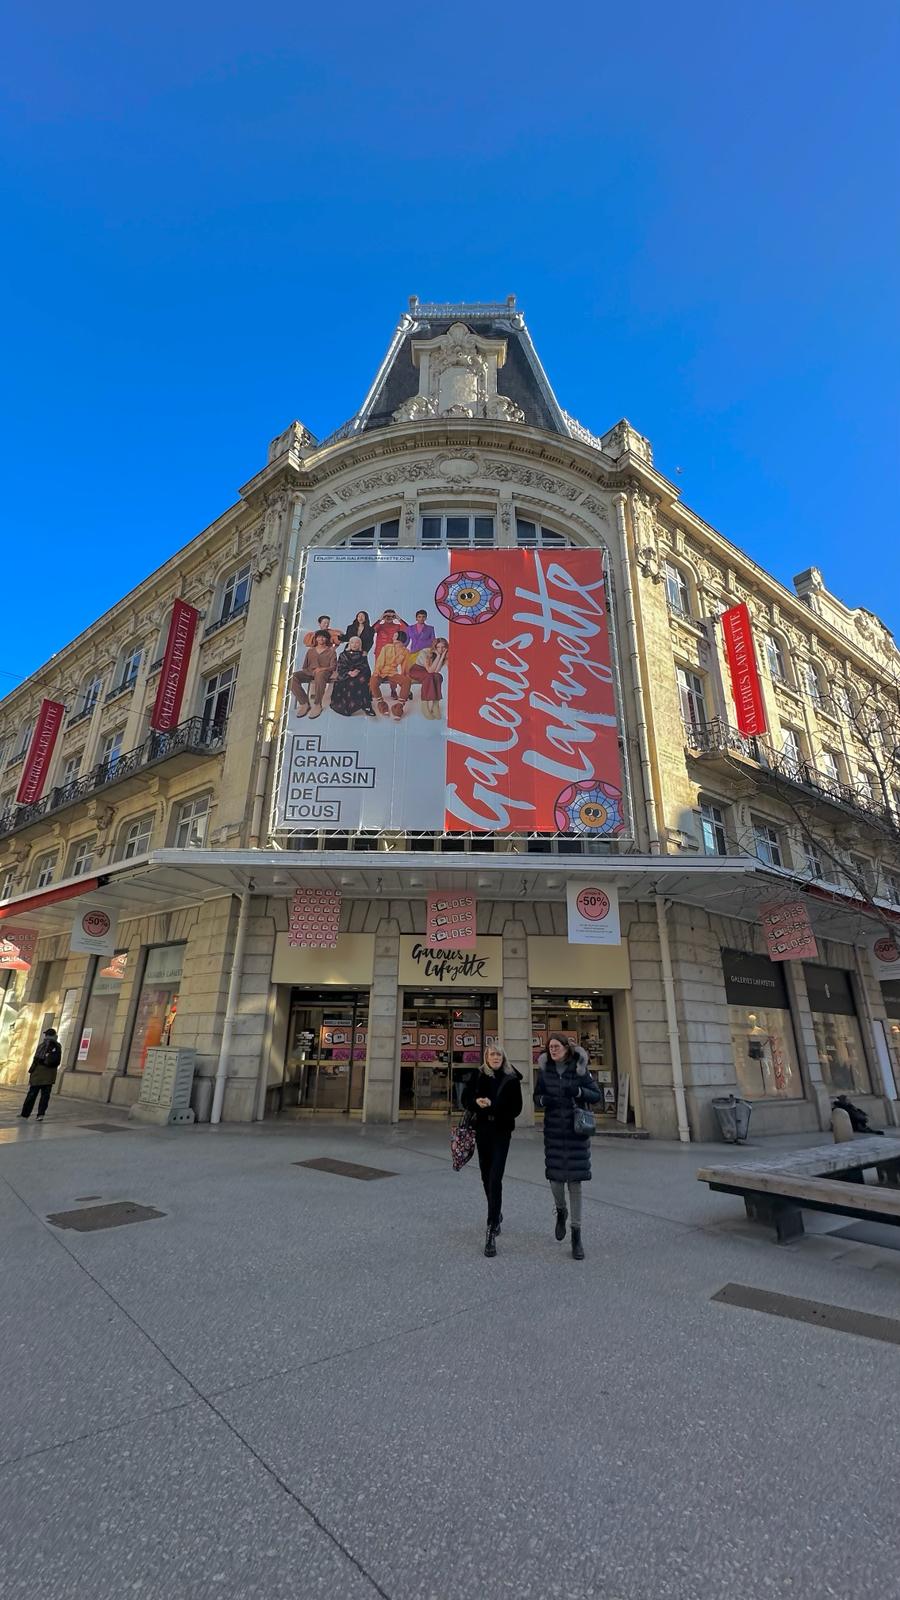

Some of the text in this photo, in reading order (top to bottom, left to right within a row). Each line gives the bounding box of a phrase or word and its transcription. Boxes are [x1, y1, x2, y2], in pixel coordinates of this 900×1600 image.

[160, 609, 192, 729] GALERIES LAFAYETTE
[729, 611, 757, 734] GALERIES LAFAYETTE
[446, 550, 616, 830] Galeries Lafayette
[295, 740, 316, 751] LE
[24, 705, 58, 802] GALERIES LAFAYETTE
[294, 756, 353, 767] GRAND
[292, 772, 368, 783] MAGASIN
[290, 788, 313, 800] DE
[288, 805, 334, 817] TOUS
[579, 896, 607, 906] -50%
[424, 953, 490, 981] Lafayette
